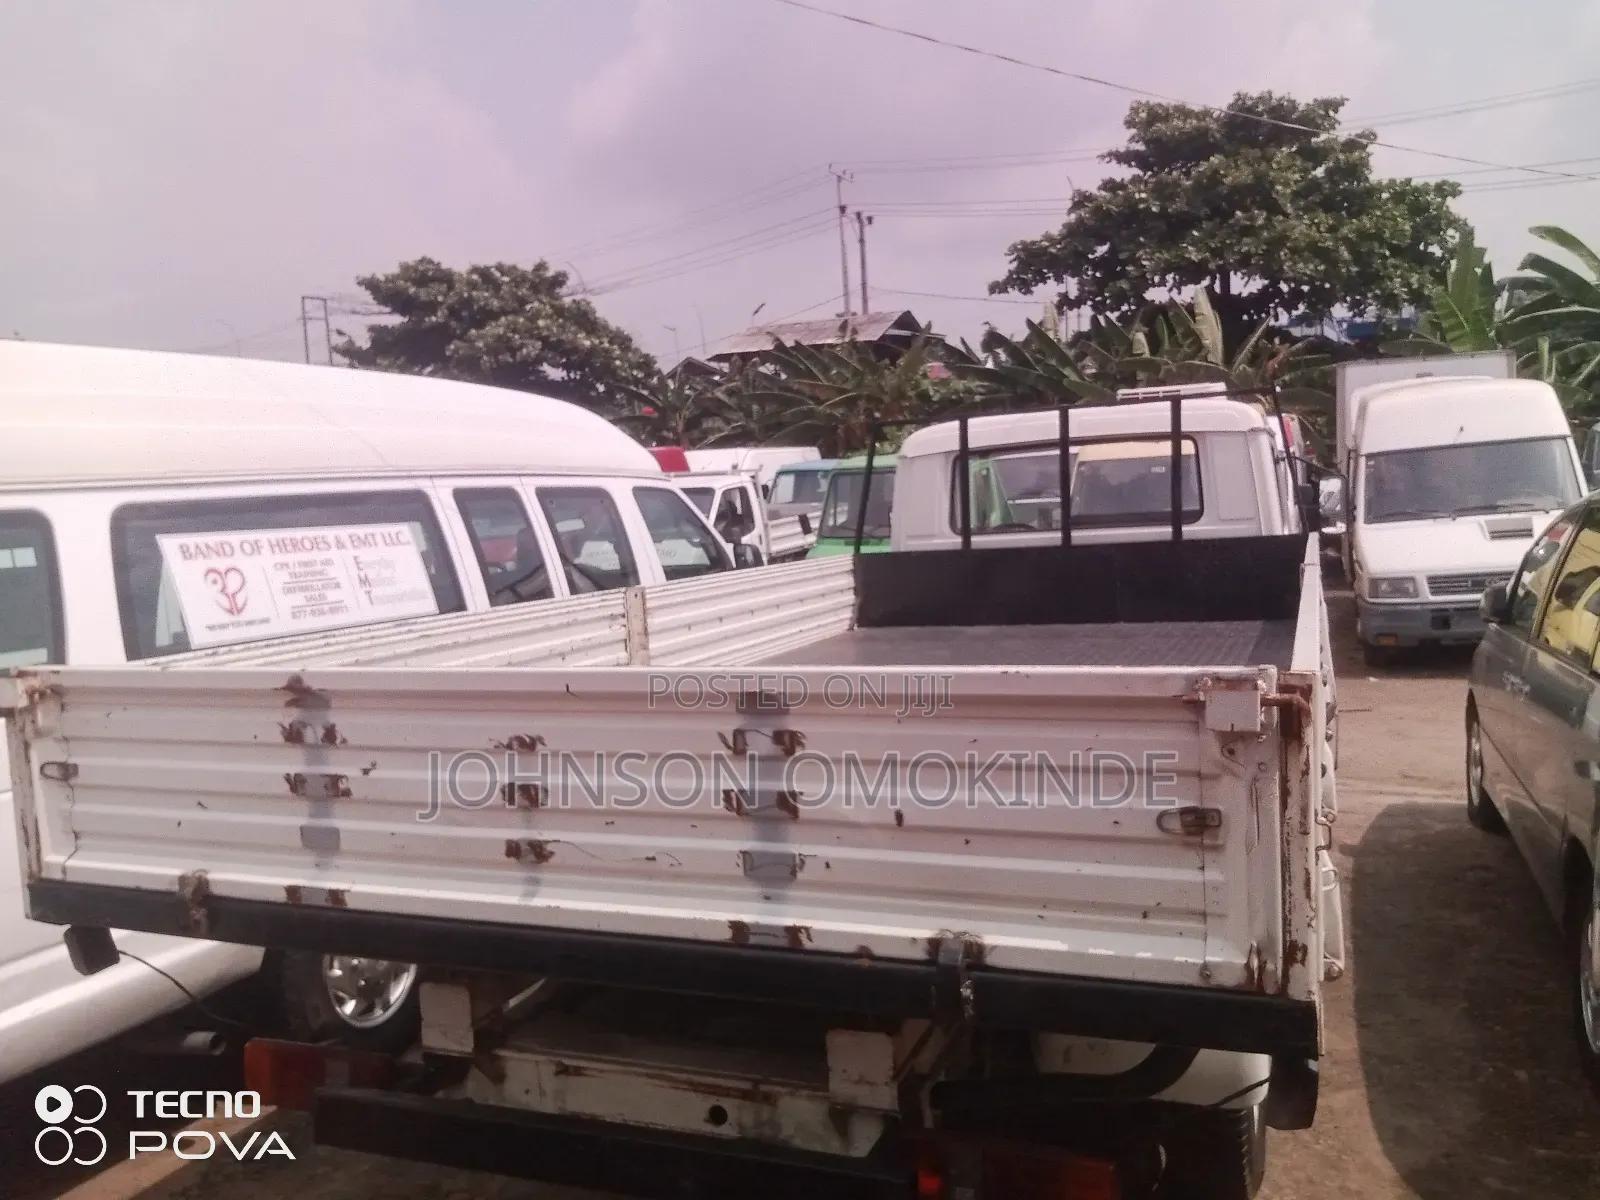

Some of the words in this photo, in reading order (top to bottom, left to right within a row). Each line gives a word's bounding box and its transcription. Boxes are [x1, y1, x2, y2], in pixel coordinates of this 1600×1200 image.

[180, 540, 236, 561] BAND
[239, 539, 263, 556] OF
[267, 534, 332, 555] HEROES
[334, 534, 347, 551] &
[348, 531, 378, 550] EMT
